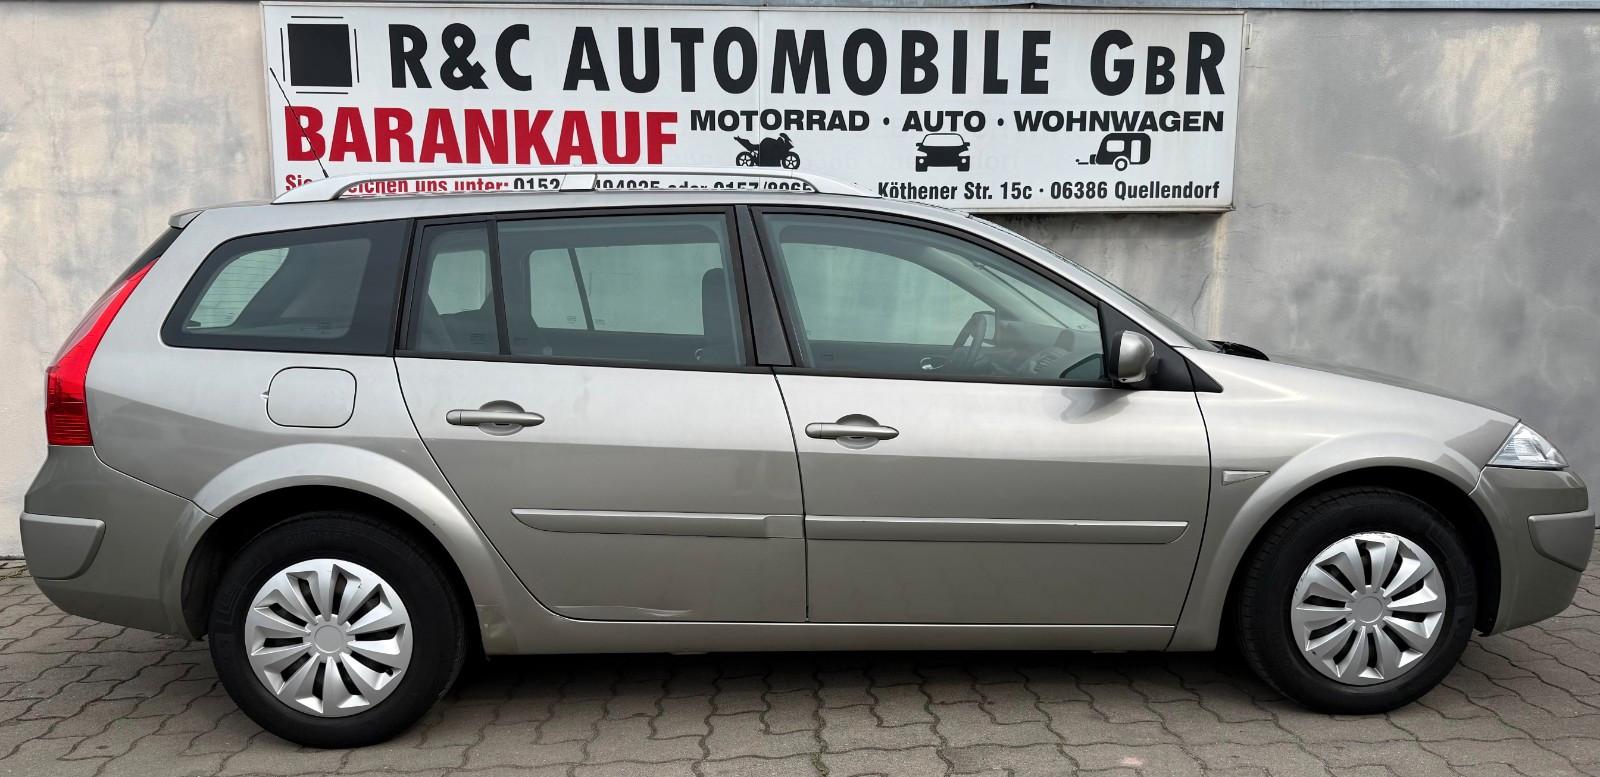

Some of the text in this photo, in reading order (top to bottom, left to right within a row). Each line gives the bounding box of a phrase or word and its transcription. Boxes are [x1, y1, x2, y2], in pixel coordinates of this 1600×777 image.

[389, 23, 533, 91] R&C
[563, 27, 1051, 96] AUTOMOBILE
[285, 106, 678, 165] BARANKAUF
[691, 109, 1224, 132] MOTORRAD AUTO WOHNWAGEN
[878, 181, 1220, 201] Köthener Str. 15c 06386 Quellendorf
